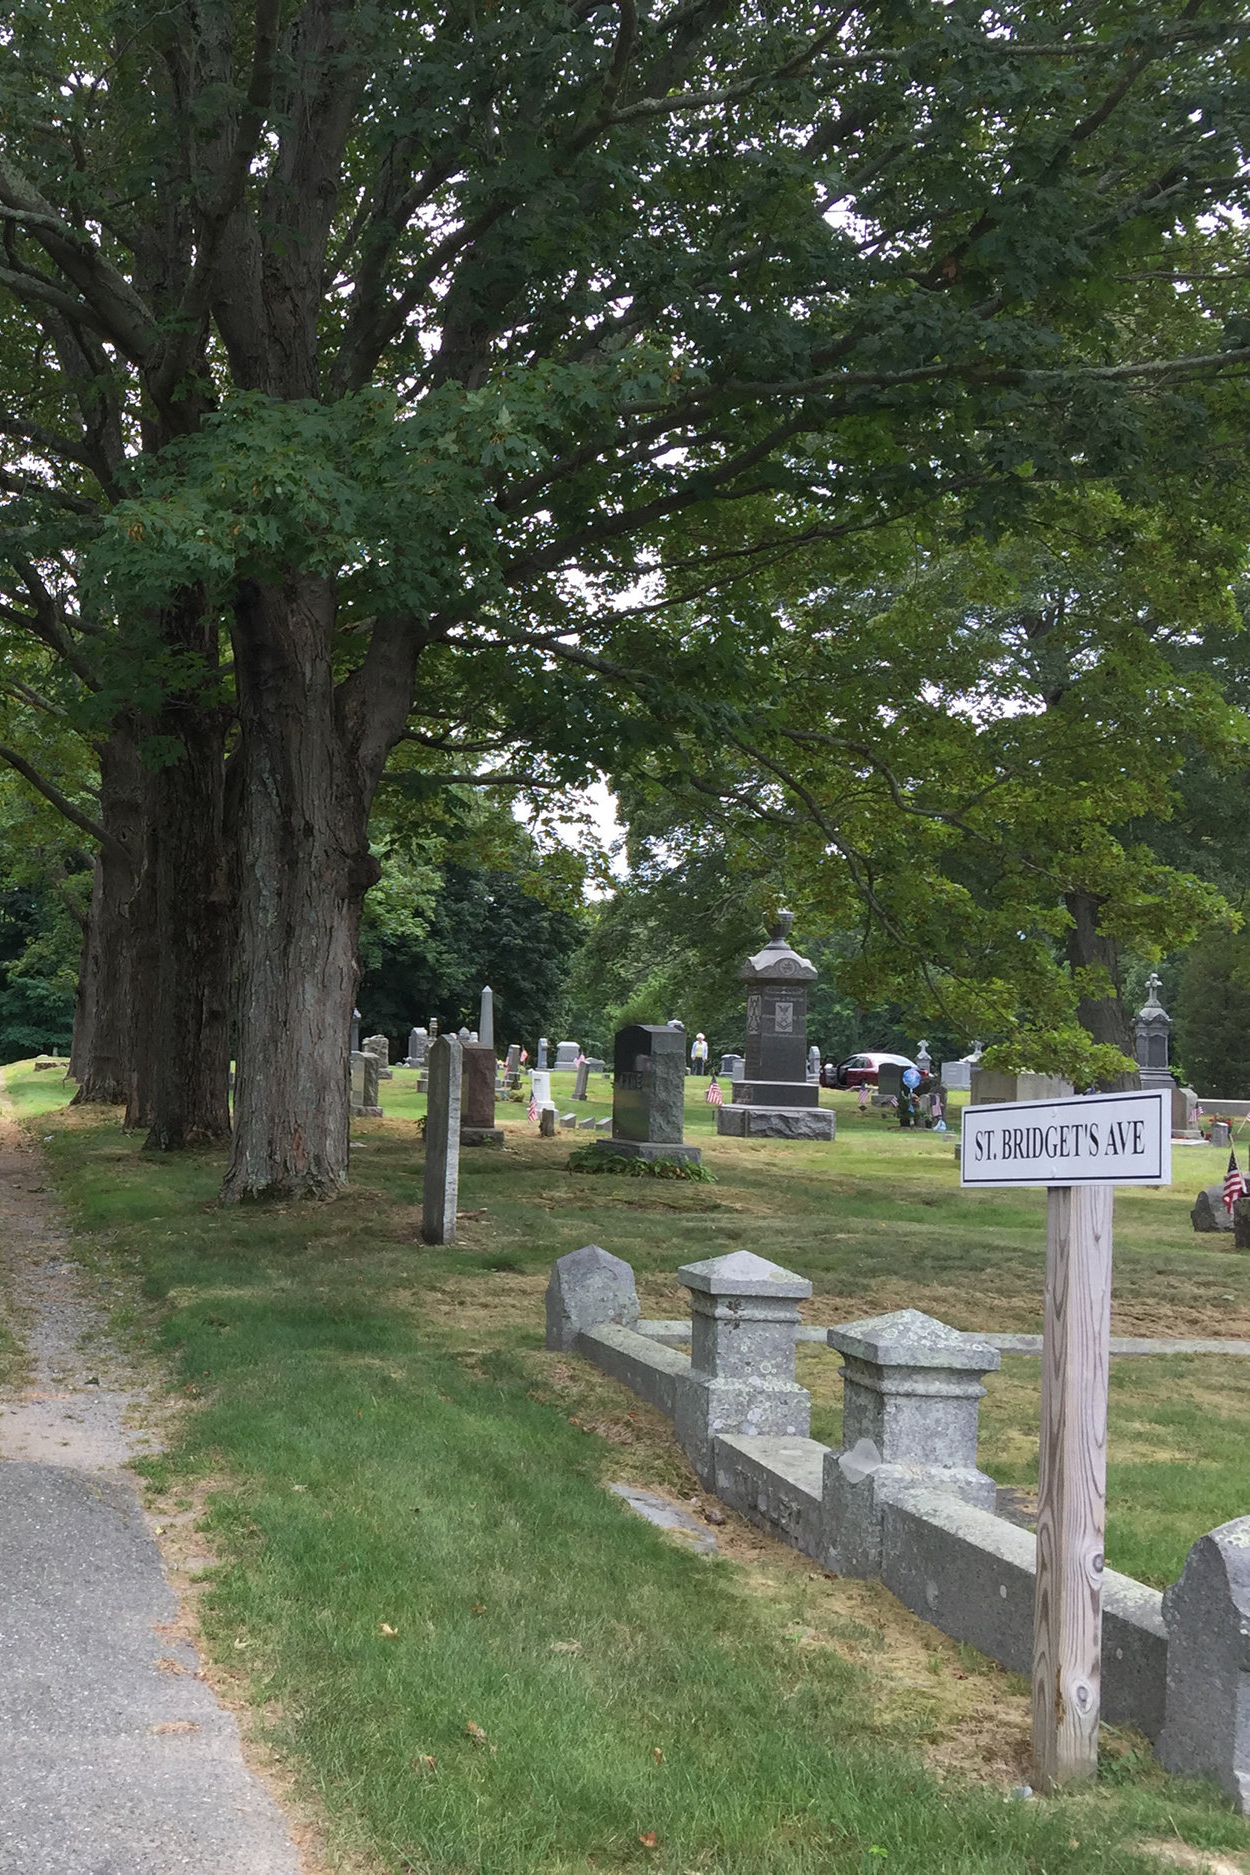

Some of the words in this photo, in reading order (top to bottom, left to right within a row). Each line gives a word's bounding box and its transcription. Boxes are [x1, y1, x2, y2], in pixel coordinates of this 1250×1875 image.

[975, 1130, 997, 1161] ST.
[1002, 1122, 1099, 1160] BRIDGET'S
[1104, 1120, 1145, 1156] AVE
